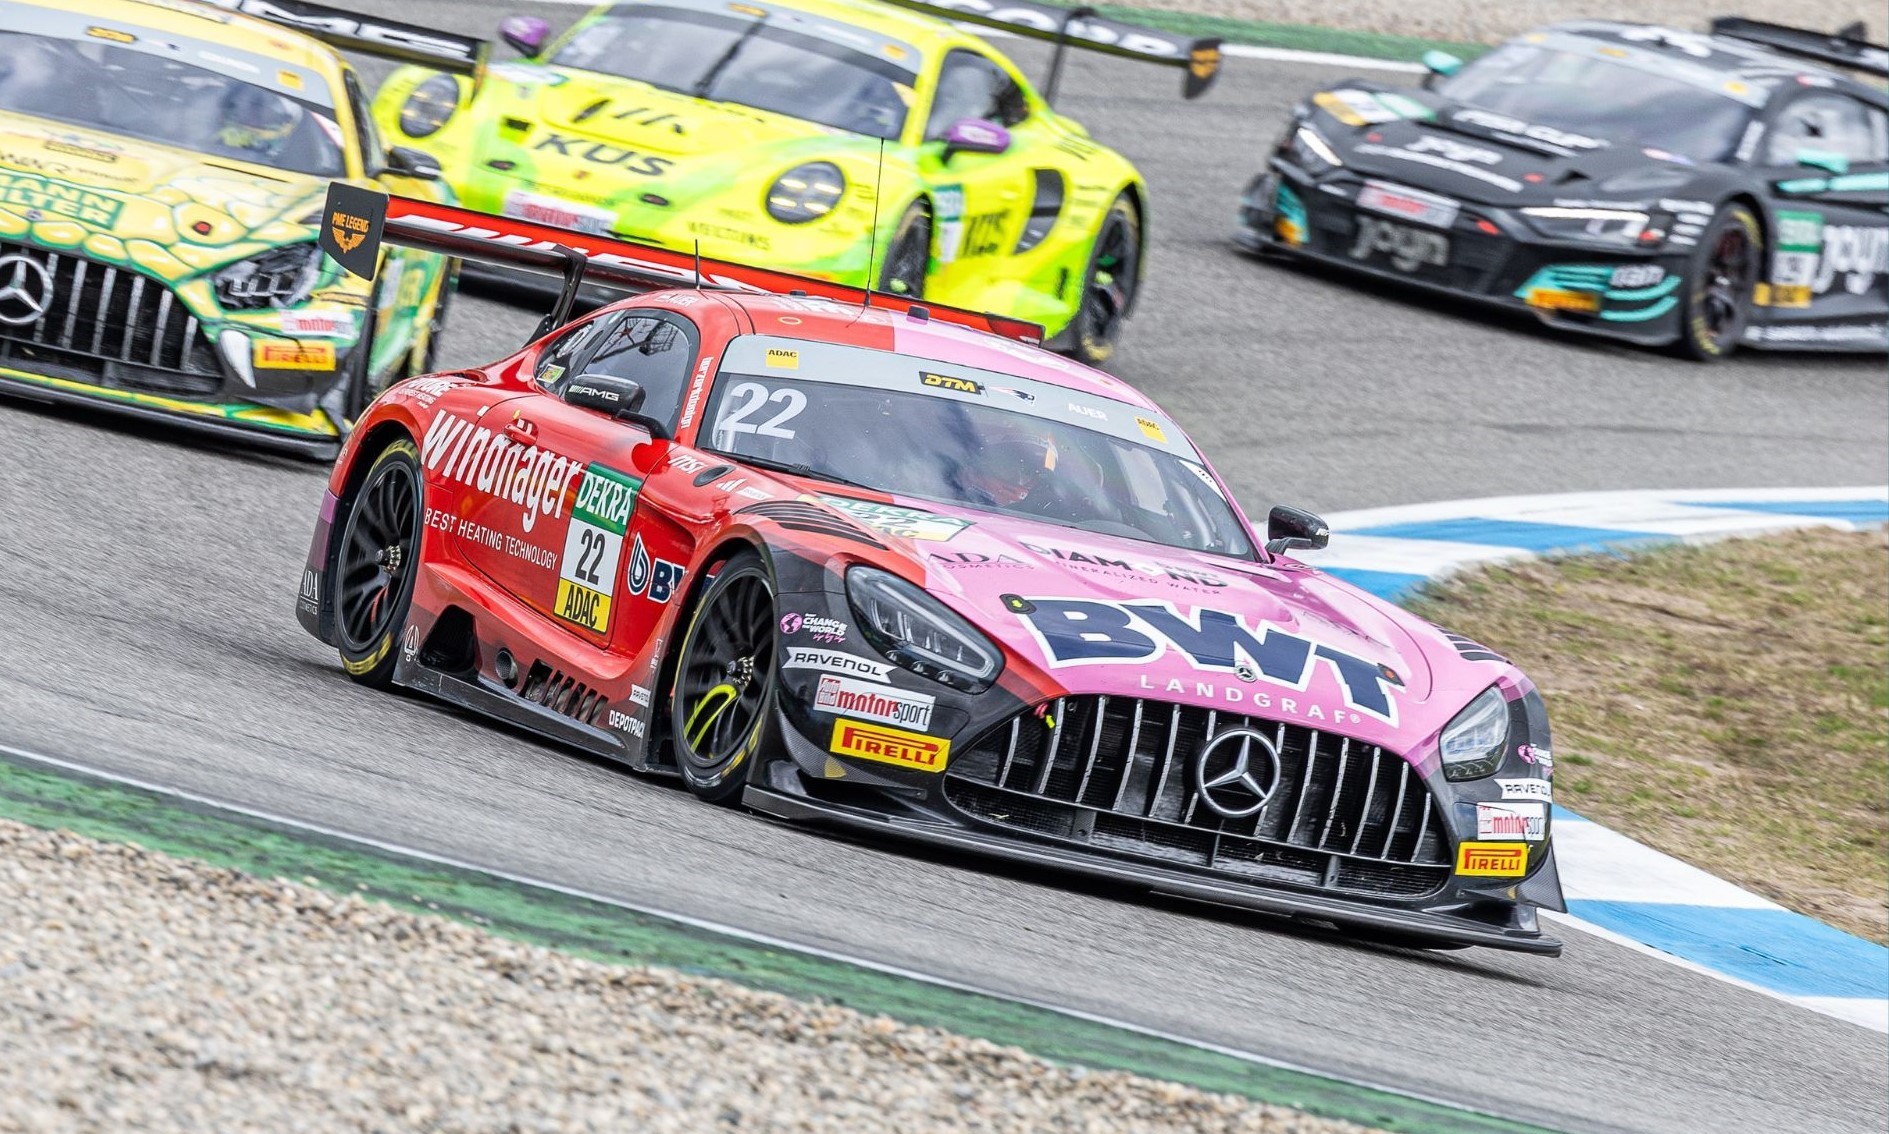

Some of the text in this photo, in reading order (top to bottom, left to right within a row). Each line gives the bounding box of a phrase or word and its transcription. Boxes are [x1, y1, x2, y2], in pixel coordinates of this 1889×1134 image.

[332, 211, 370, 232] PME LEGEND
[768, 349, 797, 358] ADAC
[580, 387, 620, 402] AMG
[924, 373, 976, 392] DTM
[719, 382, 807, 440] 22
[1068, 403, 1108, 422] AUER
[575, 471, 634, 527] DEKRA
[820, 497, 967, 527] DEKRA
[425, 507, 558, 571] BEST HEATING TECHNOLOGY
[574, 528, 606, 586] 22
[563, 585, 600, 629] ADAC
[803, 616, 848, 631] CHANGE
[809, 625, 846, 637] WORLD
[793, 652, 882, 676] RAVENOL
[1012, 595, 1405, 728] BWT
[837, 691, 930, 726] motorsport
[841, 726, 940, 766] PIRELLI
[1463, 849, 1522, 871] PIRELLI
